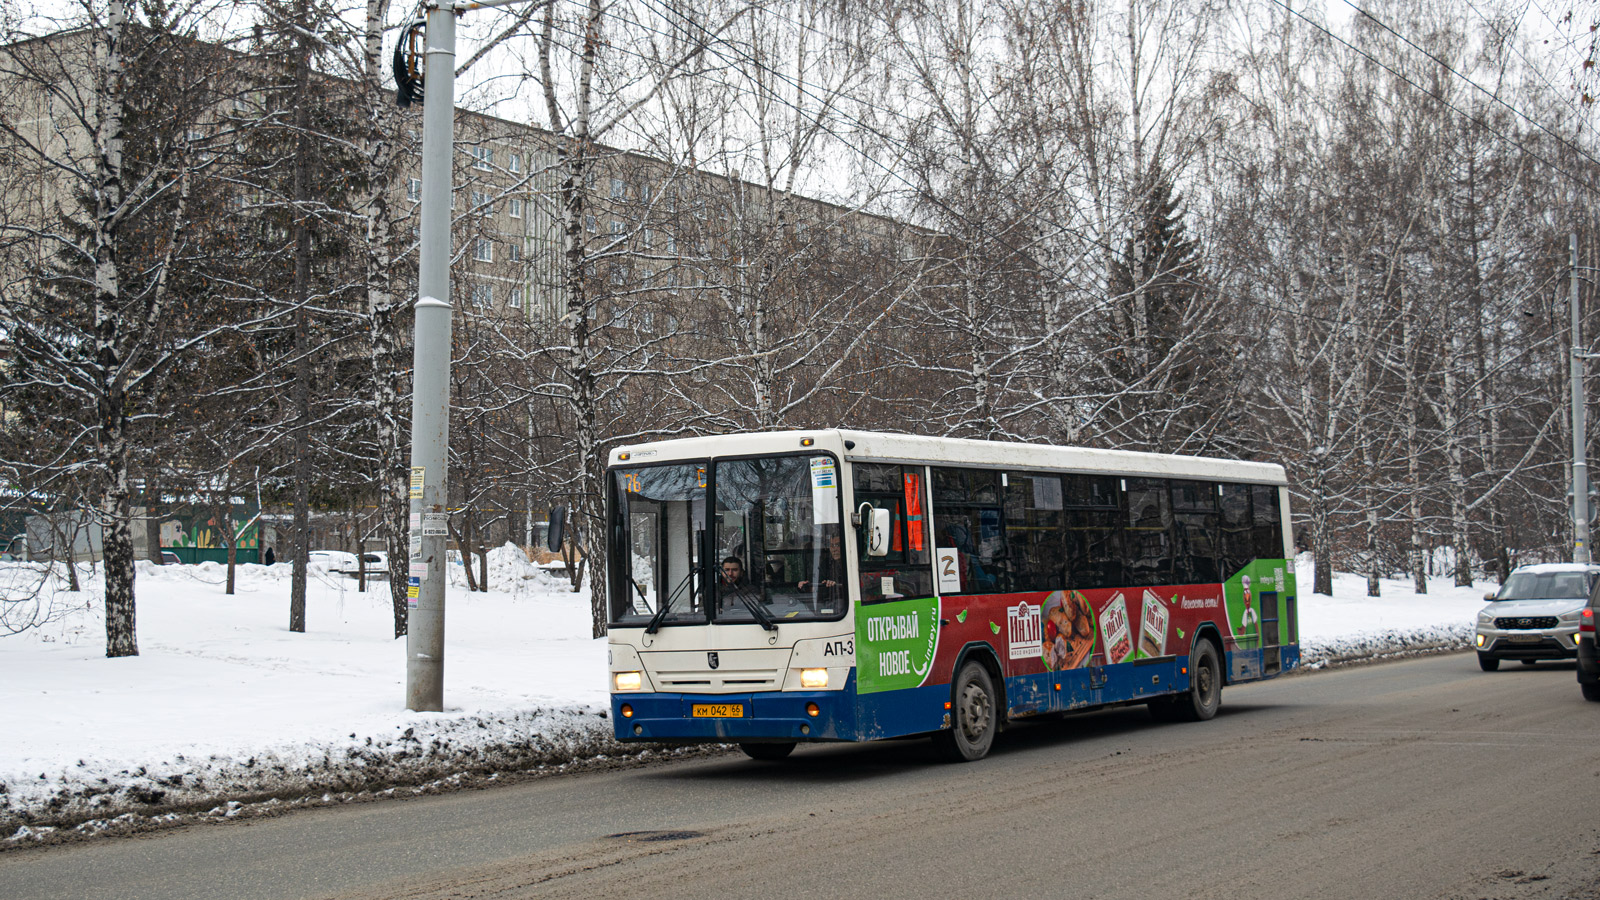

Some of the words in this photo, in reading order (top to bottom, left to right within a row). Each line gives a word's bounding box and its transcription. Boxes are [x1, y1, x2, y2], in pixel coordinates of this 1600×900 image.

[625, 474, 641, 493] 76
[867, 611, 920, 642] ОТКРЫВАЙ
[823, 641, 854, 657] АП-3
[879, 650, 911, 677] НОВОЕ
[697, 708, 708, 716] КМ
[711, 706, 727, 716] 042
[731, 704, 741, 713] 66
